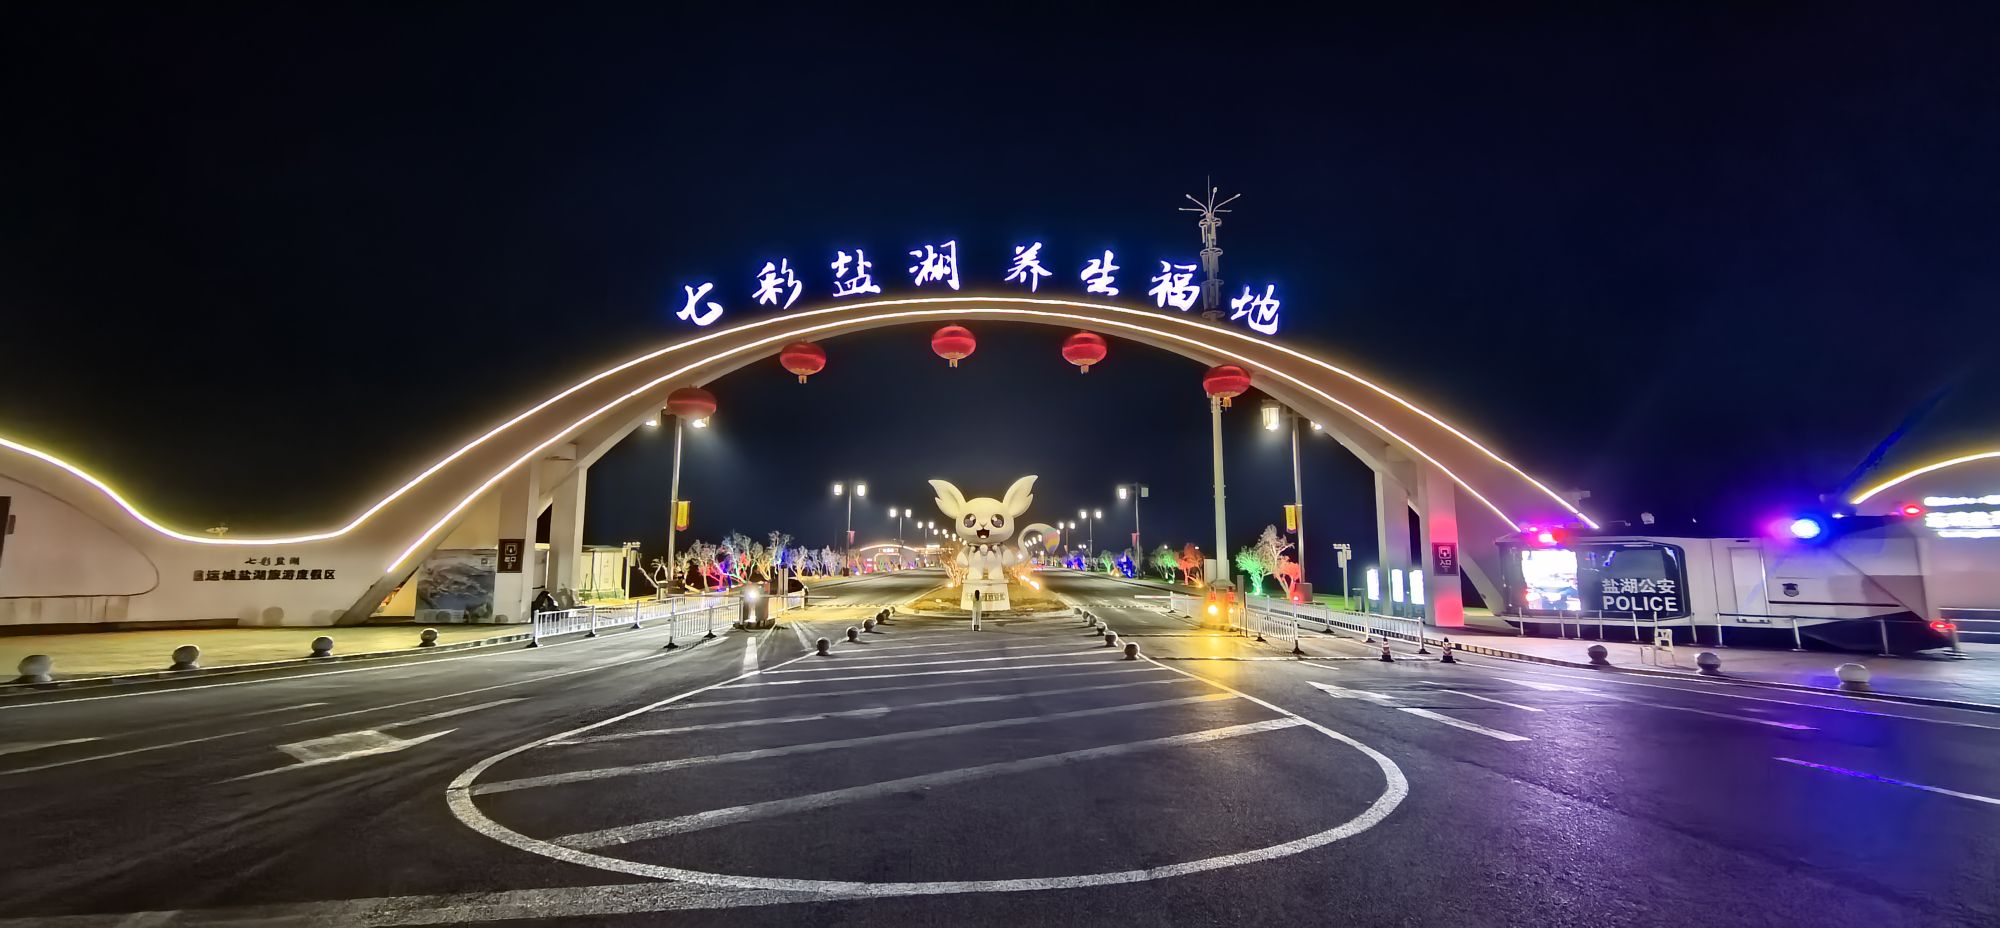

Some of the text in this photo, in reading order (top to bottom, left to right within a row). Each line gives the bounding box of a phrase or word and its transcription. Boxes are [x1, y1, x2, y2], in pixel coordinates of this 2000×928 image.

[676, 240, 1280, 335] 七彩盐湖养生福地
[1601, 578, 1676, 594] 盐湖公安
[1602, 595, 1679, 612] POLICE
